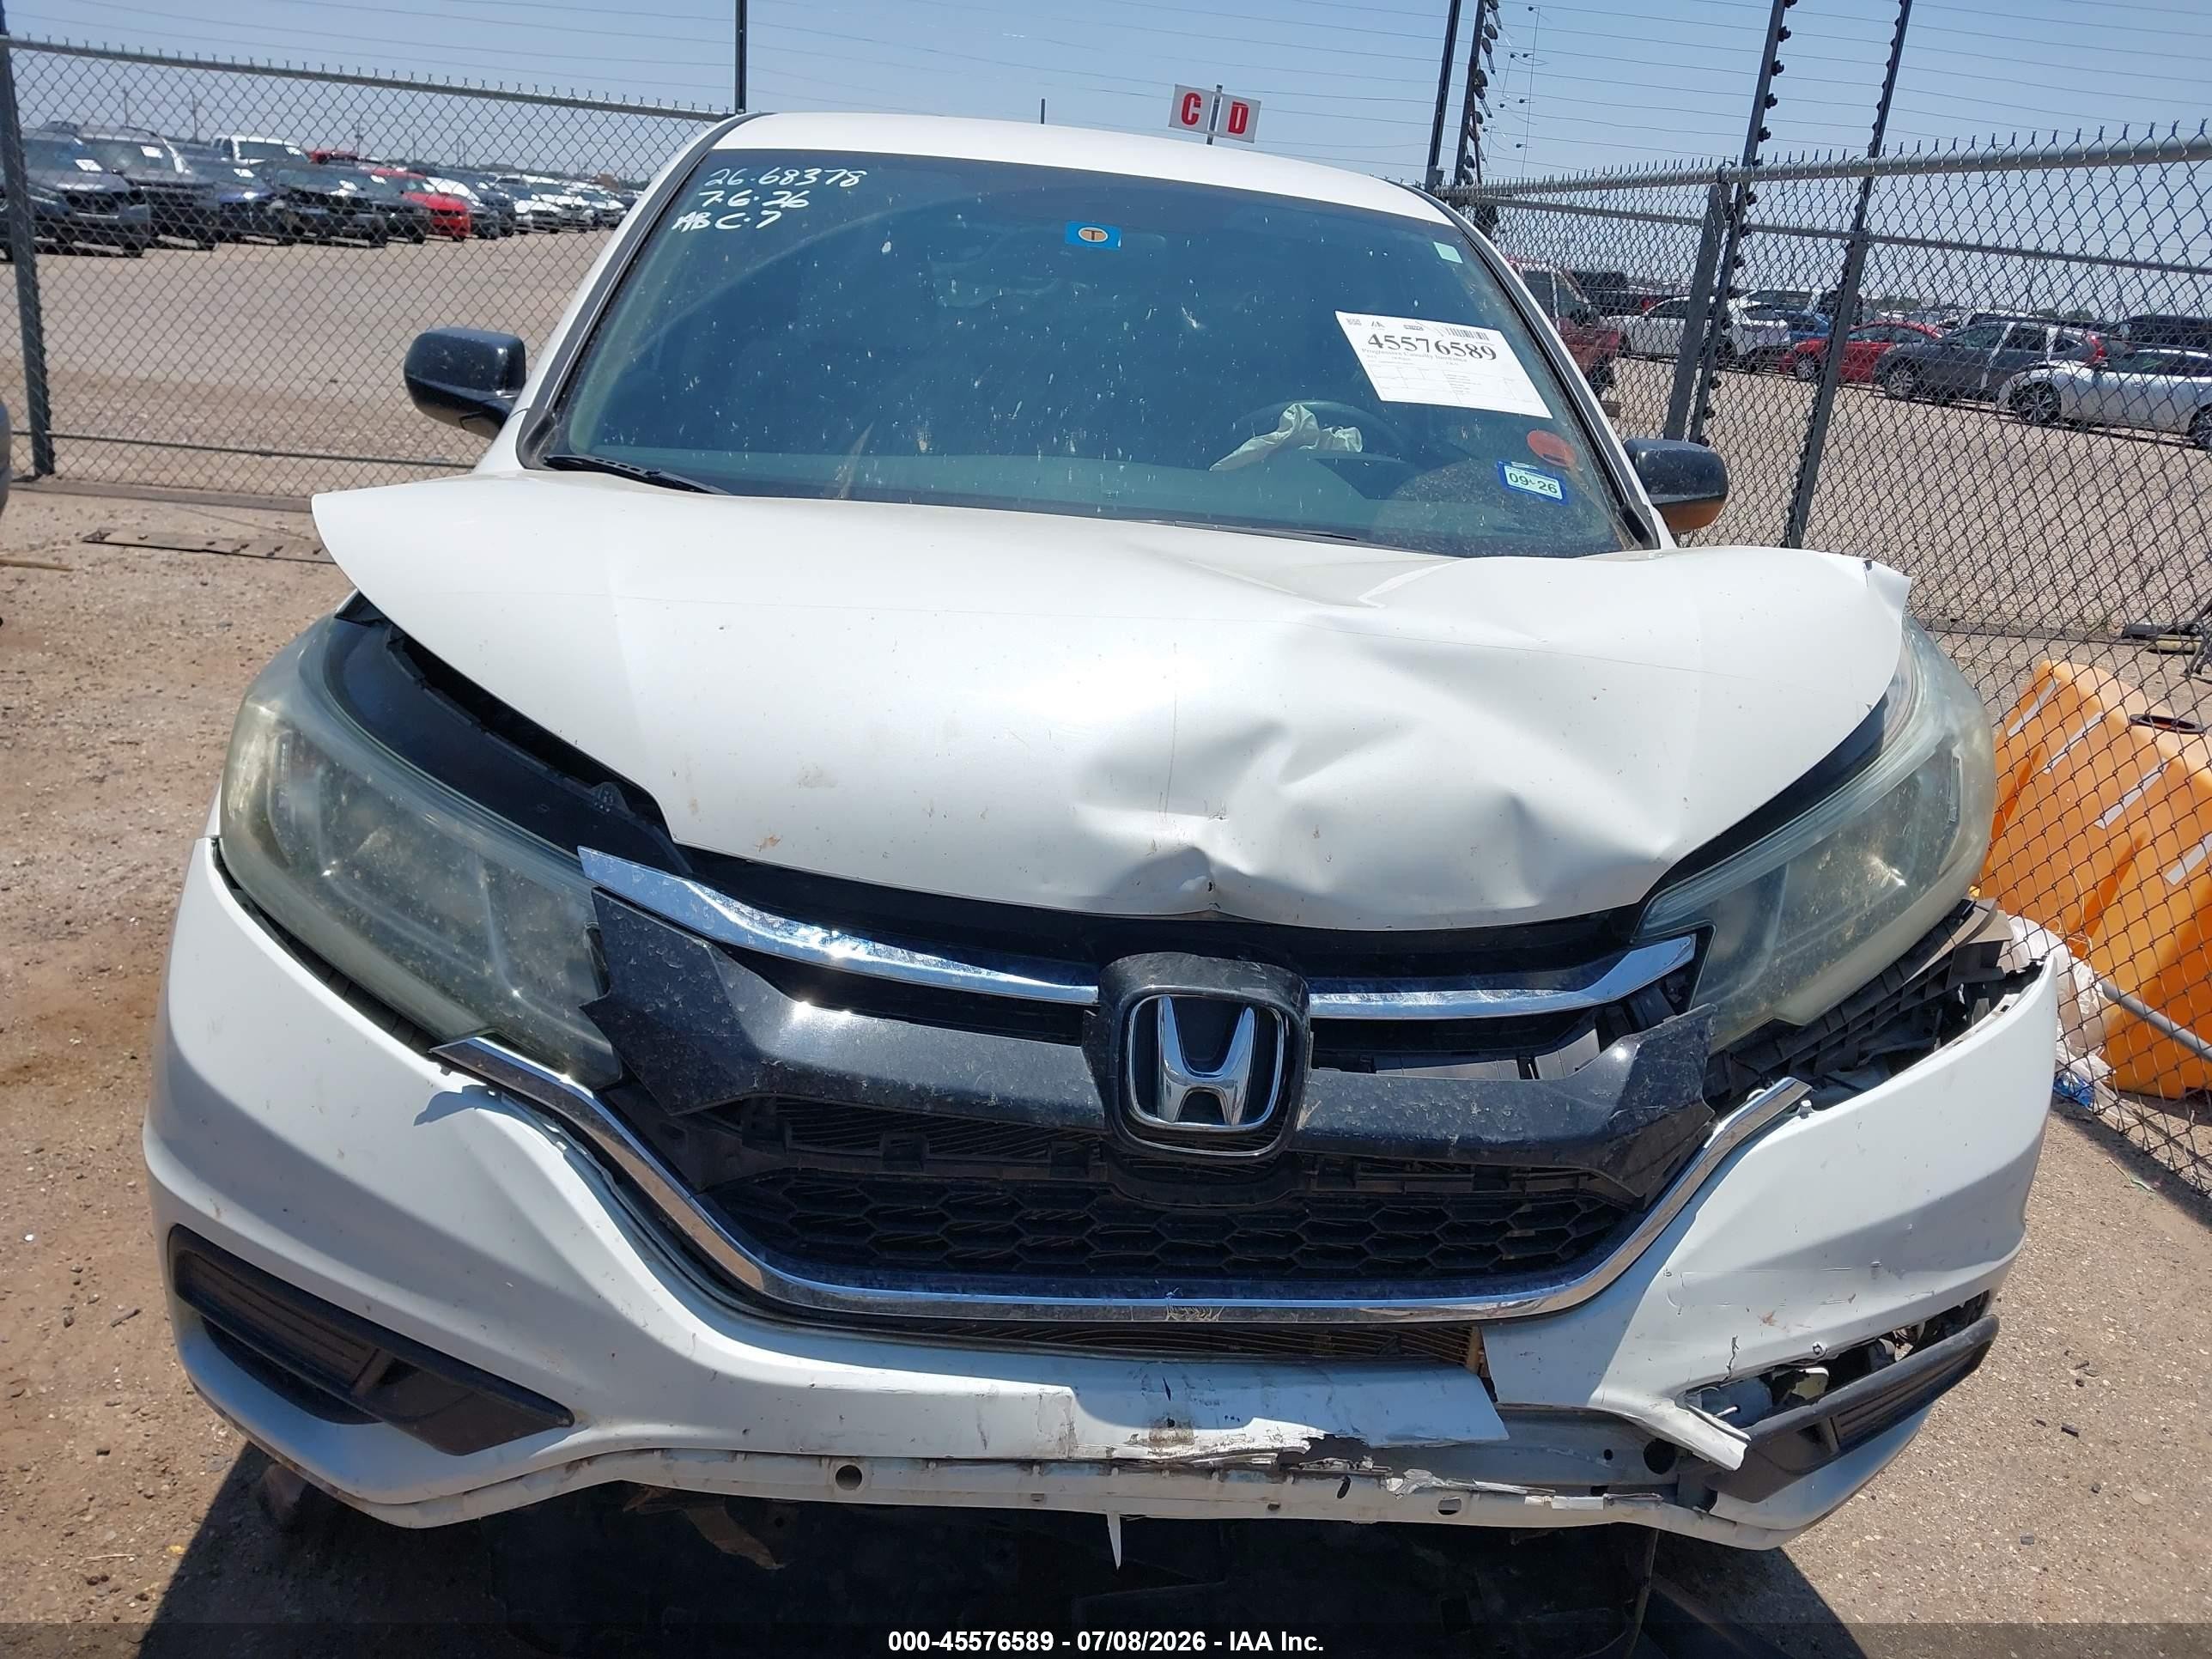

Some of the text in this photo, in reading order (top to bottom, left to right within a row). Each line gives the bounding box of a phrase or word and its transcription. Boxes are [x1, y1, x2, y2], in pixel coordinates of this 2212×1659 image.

[1181, 92, 1249, 135] C D
[1367, 333, 1498, 361] 45576589
